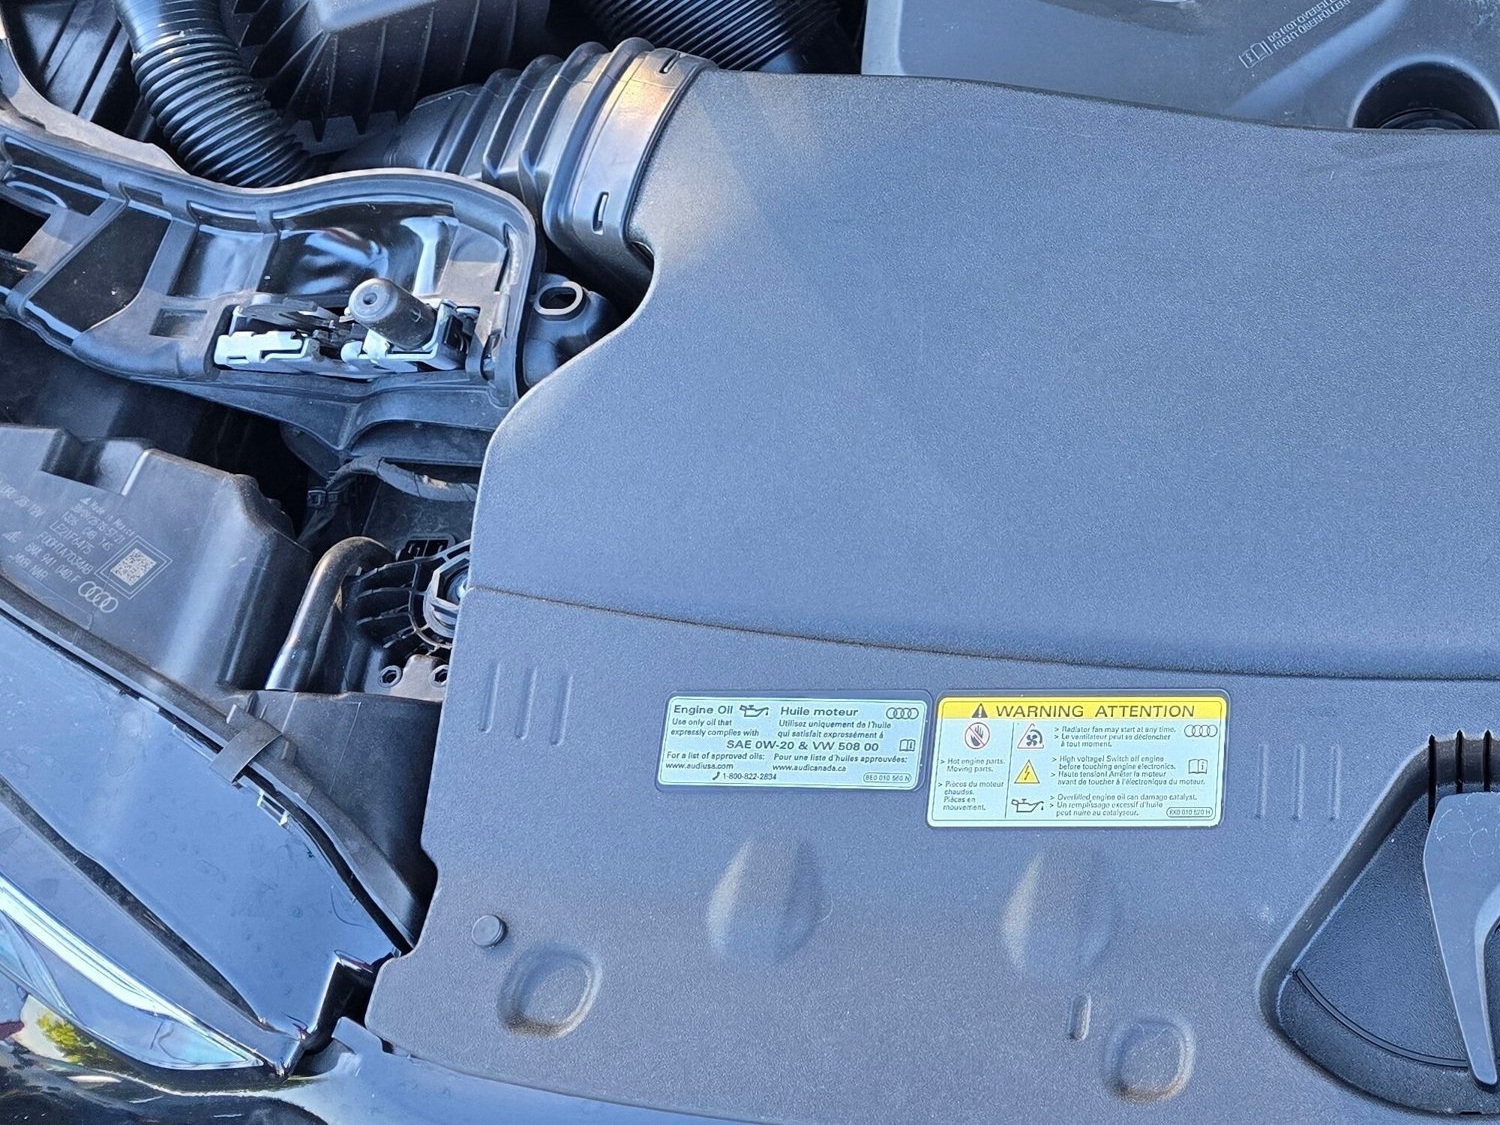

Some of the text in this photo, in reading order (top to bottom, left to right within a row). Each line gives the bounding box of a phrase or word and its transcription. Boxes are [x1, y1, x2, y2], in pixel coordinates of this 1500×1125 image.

[1279, 20, 1298, 34] NOT
[674, 704, 733, 716] Engine Oil
[780, 706, 858, 716] Huile moteur
[996, 705, 1195, 717] WARNING ATTENTION
[688, 718, 705, 727] only
[706, 718, 716, 726] oil
[778, 719, 806, 727] Utilisez
[808, 720, 854, 729] uniquement
[671, 729, 706, 737] expressly
[707, 729, 741, 737] complies
[777, 730, 790, 738] qui
[792, 730, 821, 738] satisfait
[726, 740, 879, 751] SAE 0W-20 & VW 508 00
[667, 751, 679, 759] For
[688, 751, 699, 759] list
[701, 751, 710, 759] of
[711, 752, 748, 761] approved
[773, 753, 791, 761] Pour
[810, 753, 826, 761] liste
[1059, 755, 1075, 763] High
[665, 762, 734, 770] www.audiusa.com
[961, 758, 984, 766] engine
[772, 764, 846, 772] www.audicanada.ca
[1082, 763, 1112, 771] touching
